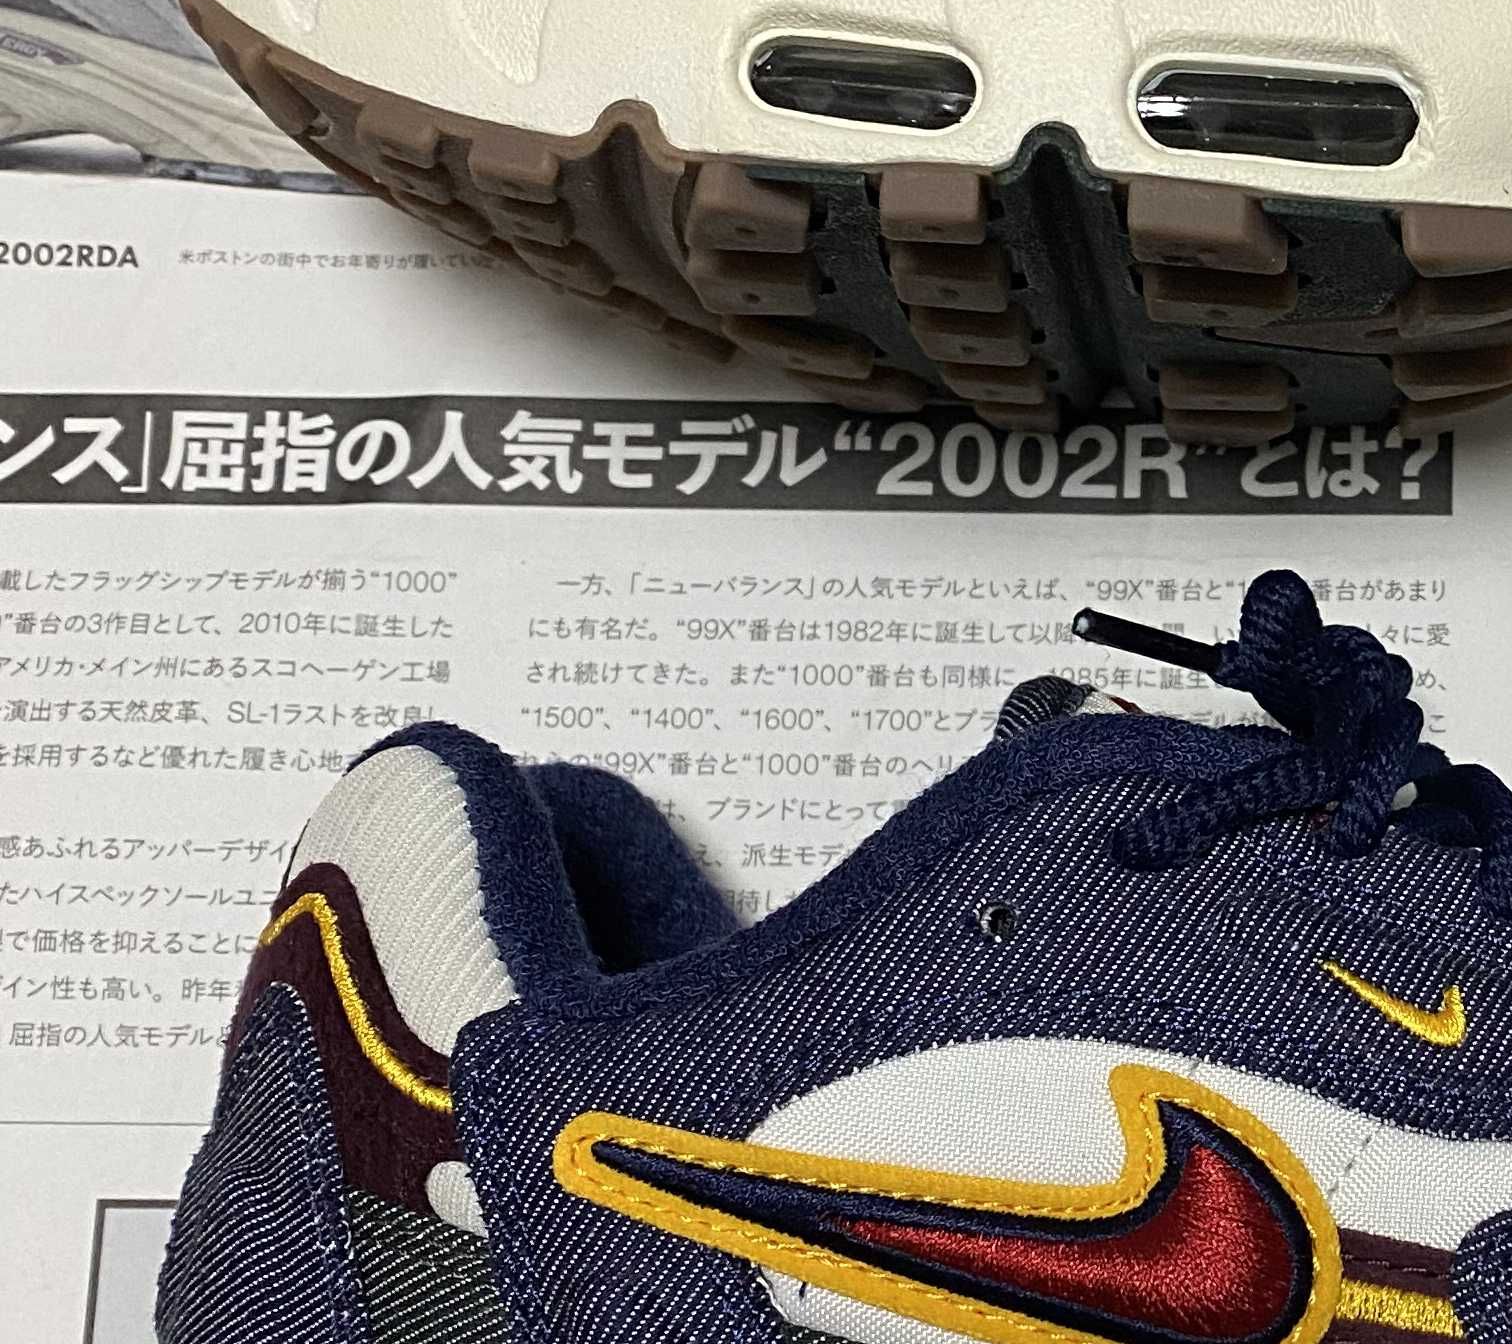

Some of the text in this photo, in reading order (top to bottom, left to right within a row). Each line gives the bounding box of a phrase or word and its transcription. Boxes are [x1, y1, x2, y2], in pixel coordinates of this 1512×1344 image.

[0, 928, 257, 955] で価格を抑えることに
